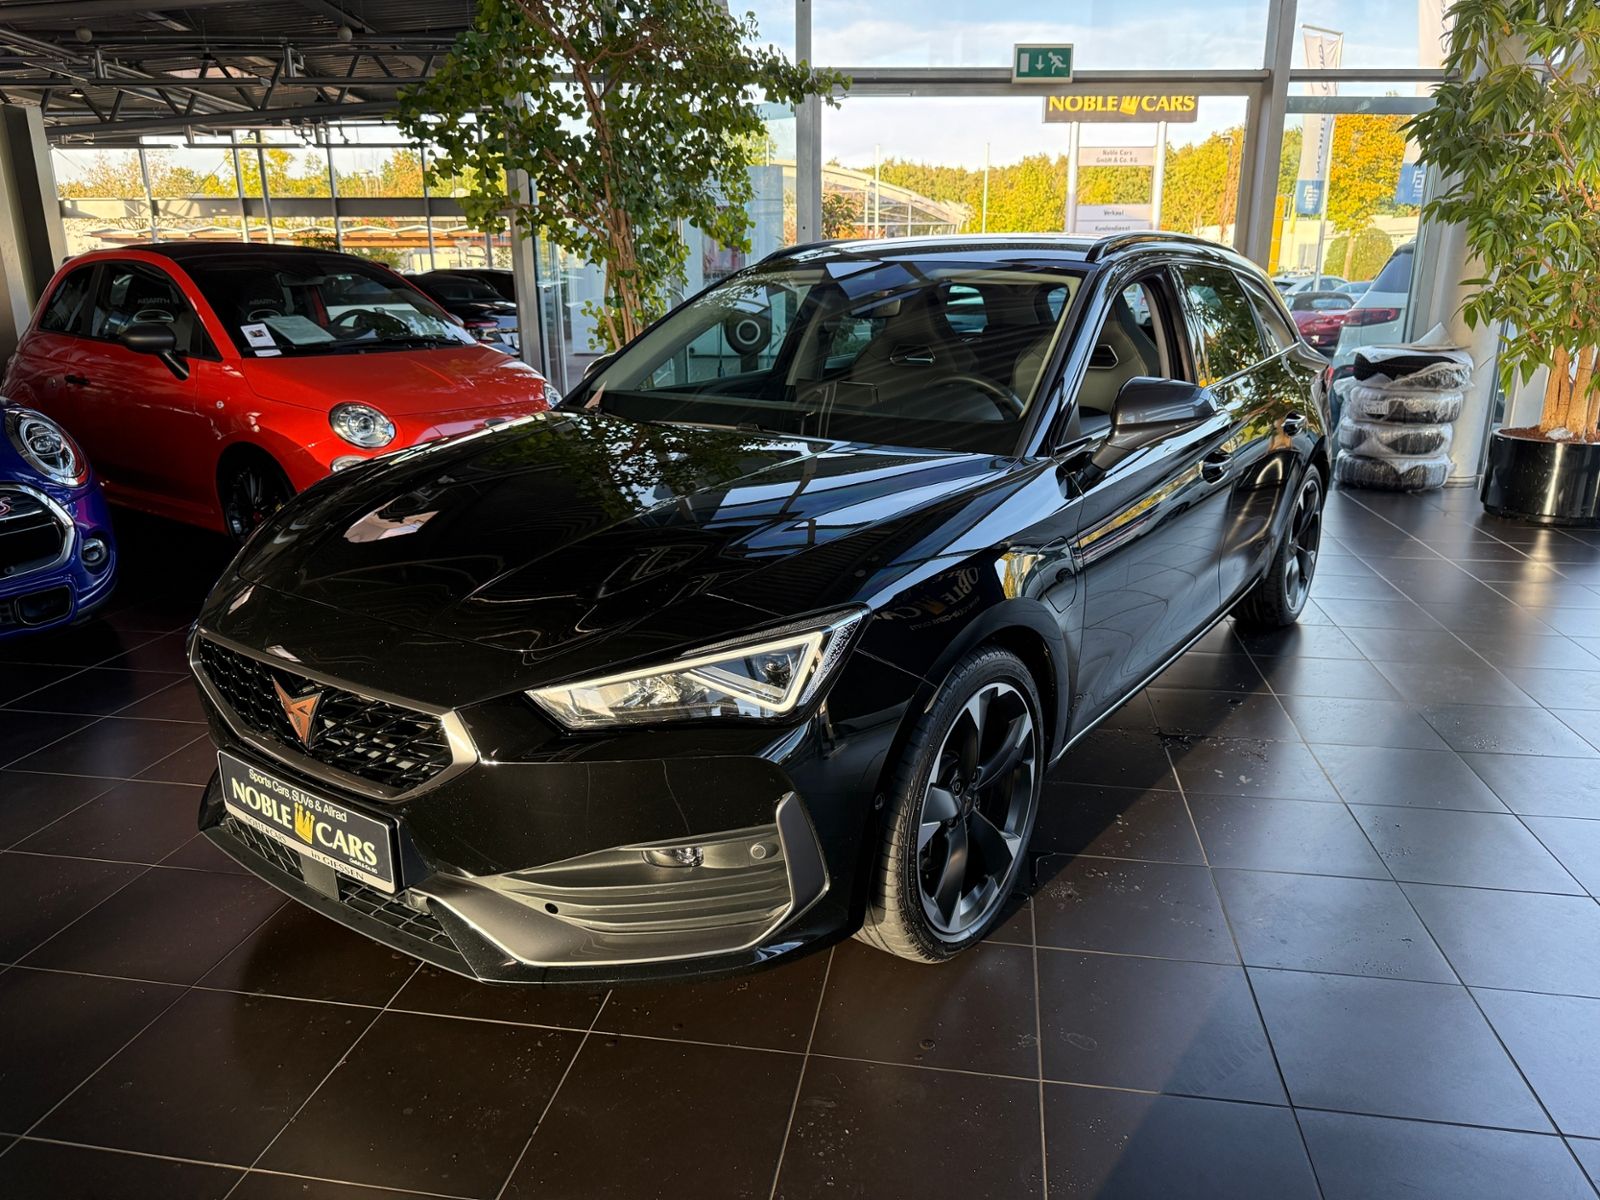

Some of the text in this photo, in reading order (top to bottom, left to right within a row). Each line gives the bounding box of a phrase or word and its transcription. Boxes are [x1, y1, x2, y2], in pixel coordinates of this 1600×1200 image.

[1049, 96, 1195, 112] NOBLE CARS
[249, 768, 271, 789] Sports
[292, 790, 314, 809] SUVs
[315, 799, 322, 812] &
[323, 803, 348, 823] Allrad
[231, 777, 378, 867] NOBLE CARS
[322, 856, 364, 880] GIESSEN
